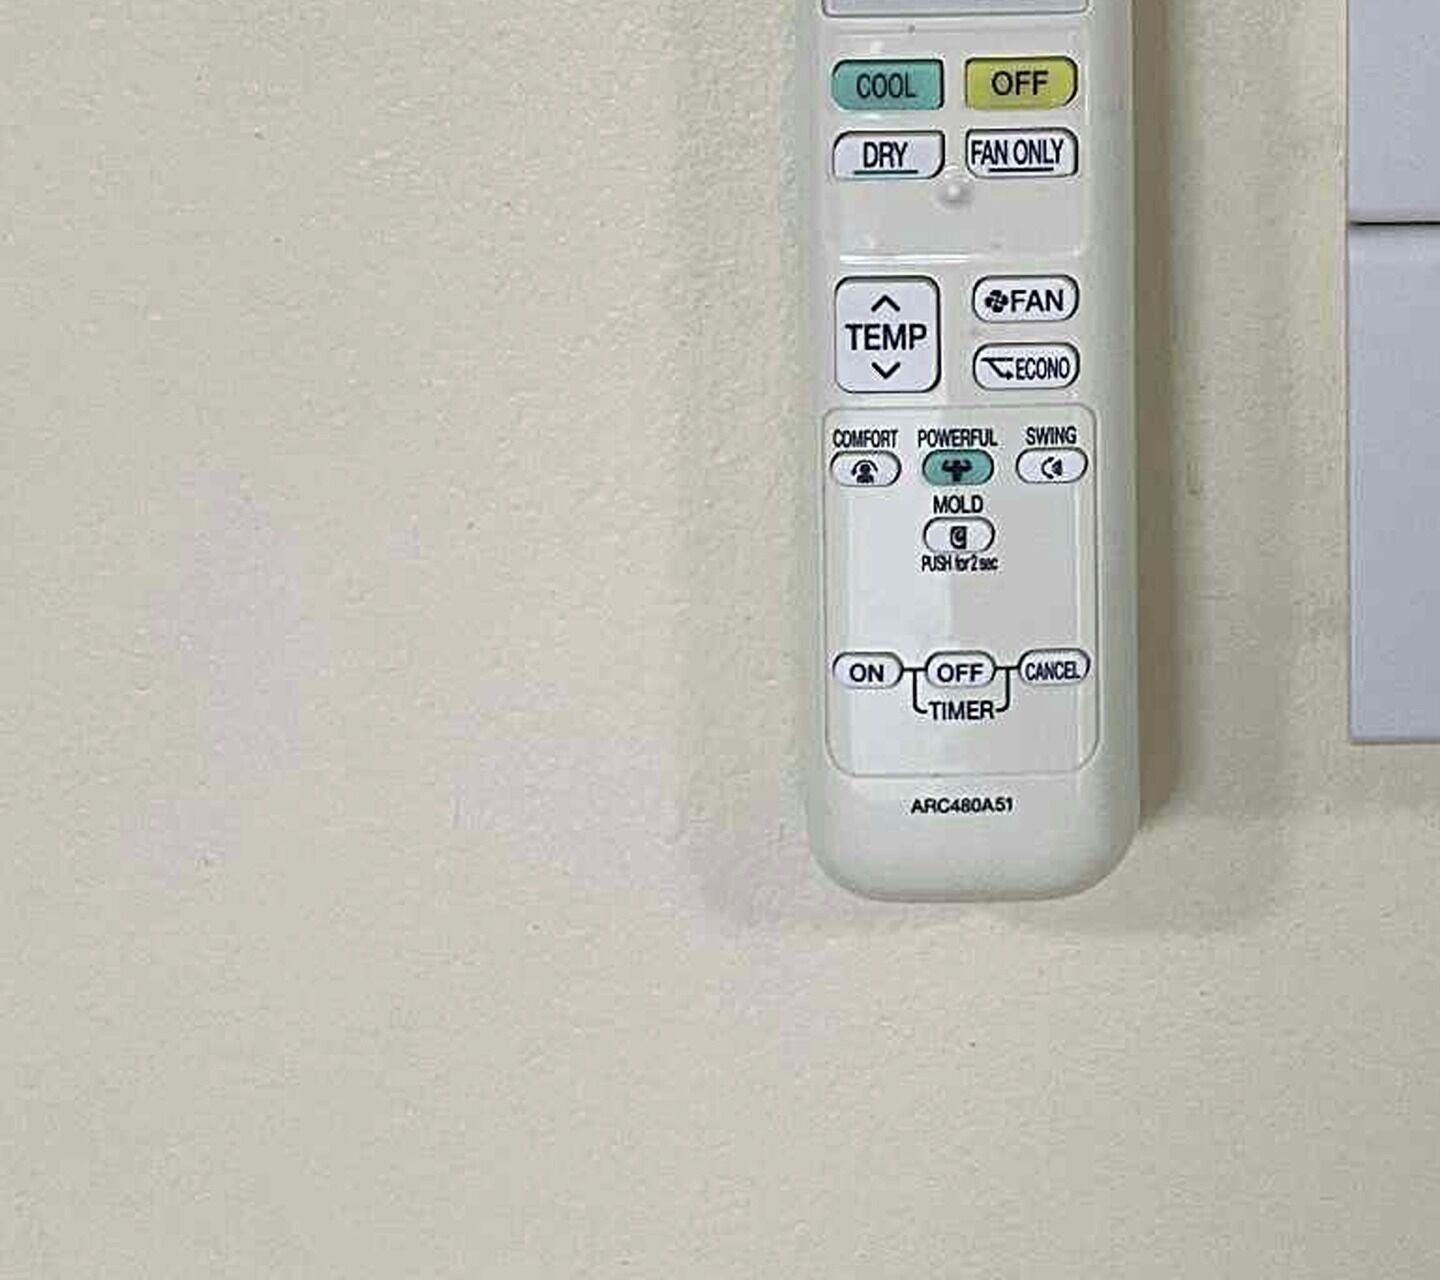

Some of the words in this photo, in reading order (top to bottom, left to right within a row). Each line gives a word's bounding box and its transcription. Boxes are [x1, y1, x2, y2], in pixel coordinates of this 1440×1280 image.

[856, 72, 917, 100] COOL
[991, 70, 1048, 96] OFF
[863, 142, 908, 168] DRY
[970, 140, 1008, 167] FAN
[1013, 139, 1064, 166] ONLY
[1010, 289, 1064, 312] FAN
[845, 324, 927, 351] TEMP
[1015, 357, 1070, 380] ECONO
[833, 429, 899, 447] COMFORT
[918, 428, 999, 447] POWERFUL
[1026, 427, 1077, 445] SWING
[933, 495, 984, 514] MOLD
[921, 555, 952, 572] PUSH
[849, 663, 885, 682] ON
[937, 663, 983, 682] OFF
[1025, 661, 1081, 681] CANCEL
[927, 701, 995, 721] TIMER
[910, 797, 1014, 814] ARC480A51
